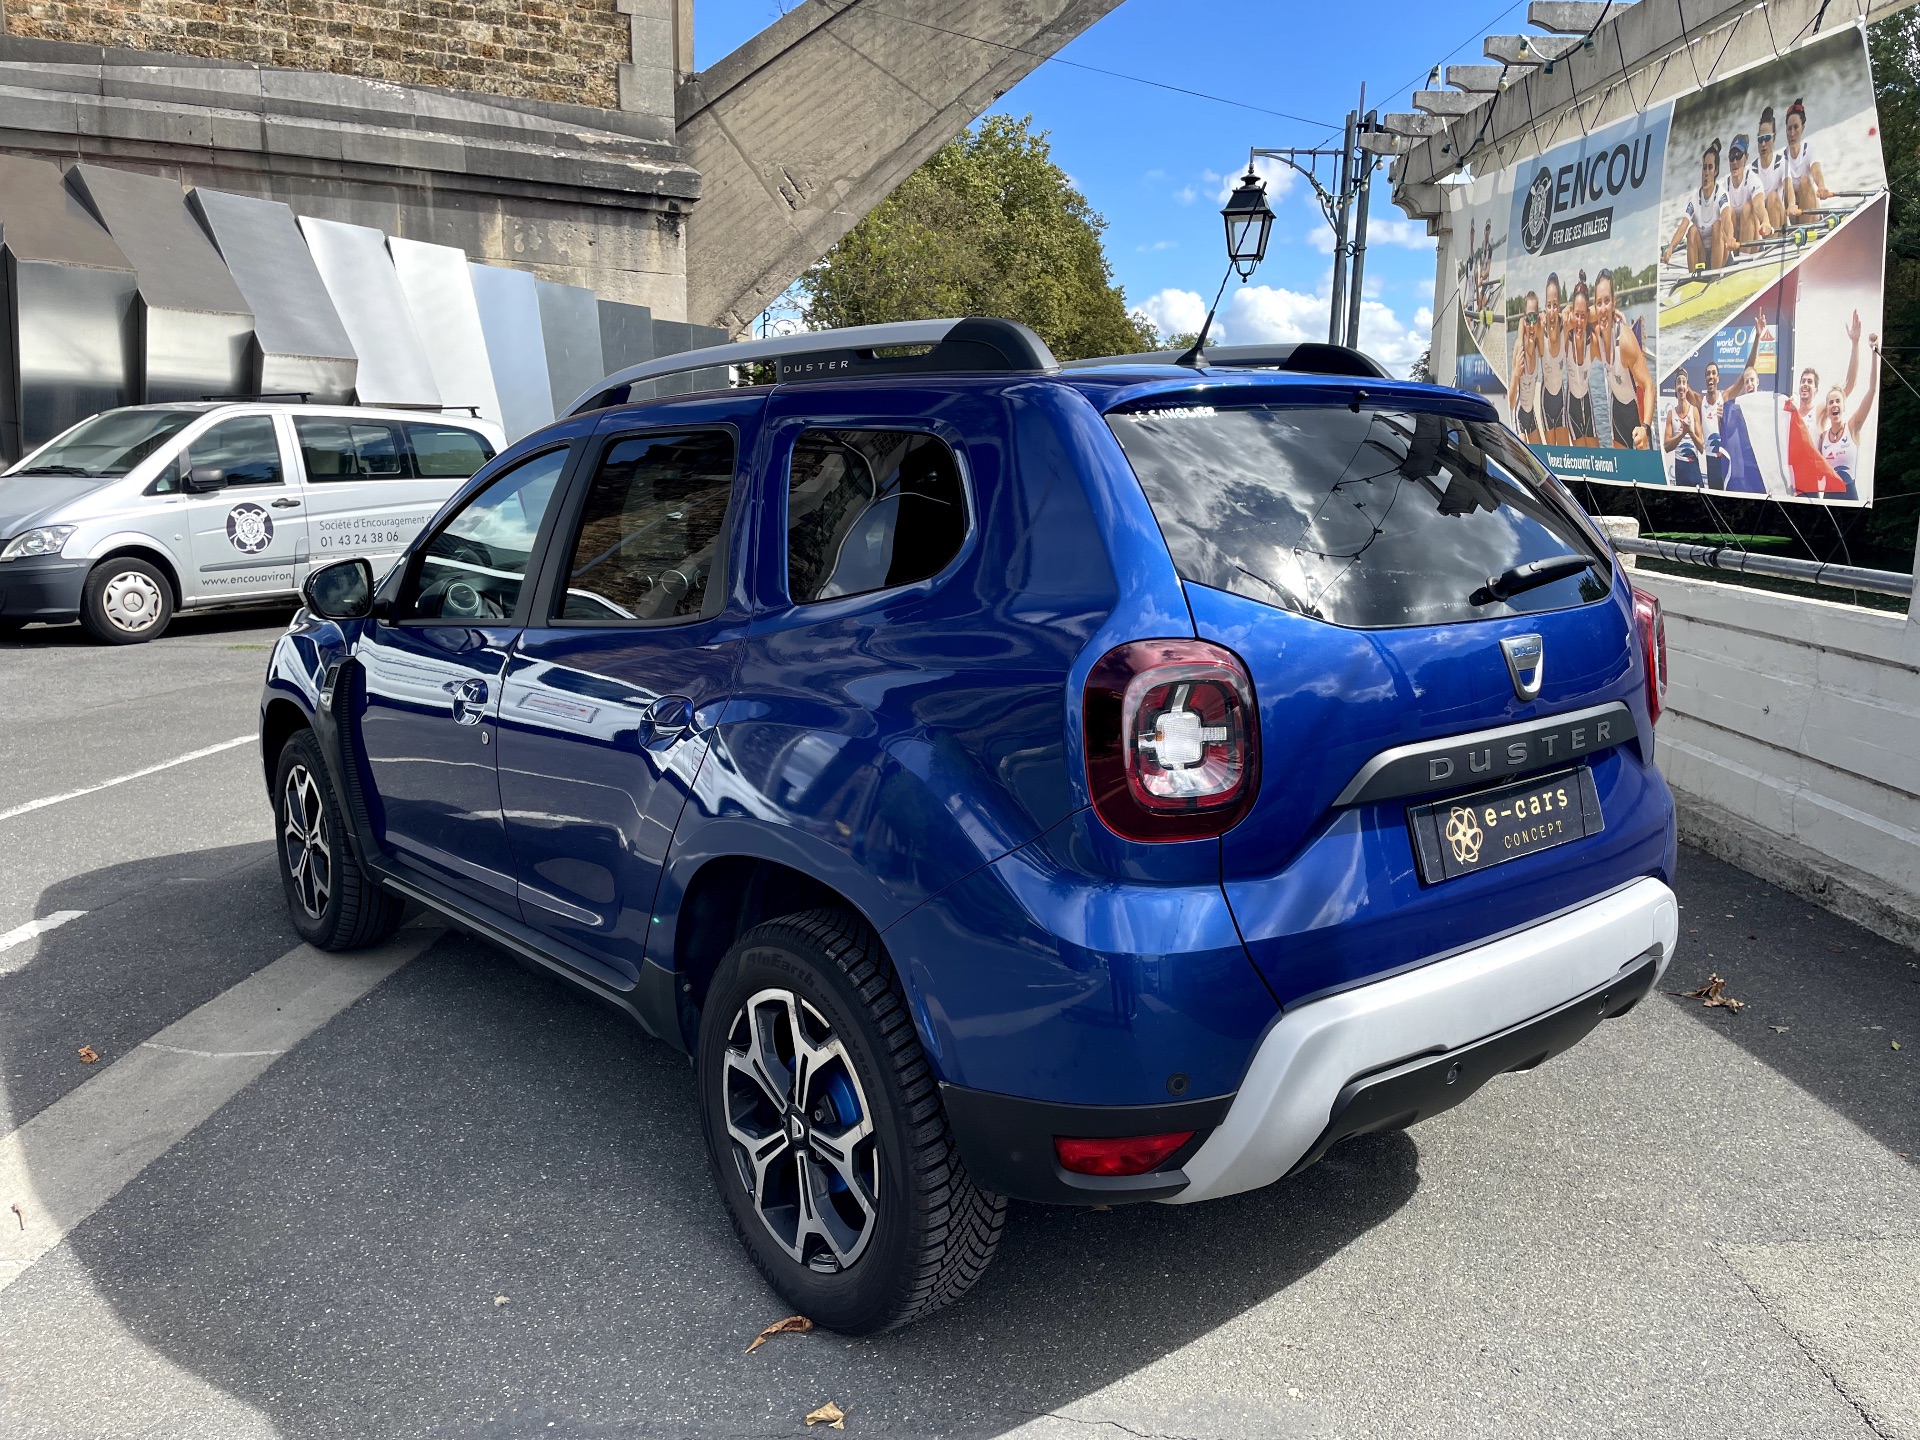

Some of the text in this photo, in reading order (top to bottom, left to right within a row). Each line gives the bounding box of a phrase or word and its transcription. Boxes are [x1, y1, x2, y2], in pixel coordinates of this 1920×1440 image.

[1554, 133, 1652, 213] ENCOU
[1552, 216, 1609, 245] FIER DE SES ATHLÈTES
[1716, 338, 1735, 347] world
[1719, 346, 1741, 356] rowing
[782, 359, 850, 374] DUSTER
[1148, 406, 1218, 420] SANGLIER
[1546, 452, 1563, 468] Venez
[1563, 453, 1590, 470] découvrir
[1591, 455, 1614, 473] l'aviron
[319, 518, 352, 531] Société
[353, 516, 425, 529] d'Encouragement
[320, 530, 399, 548] 01 43 24 38 06
[1514, 645, 1541, 657] DACIA
[1429, 721, 1612, 782] DUSTER
[1485, 786, 1569, 828] e-cars
[1504, 820, 1564, 850] CONCEPT
